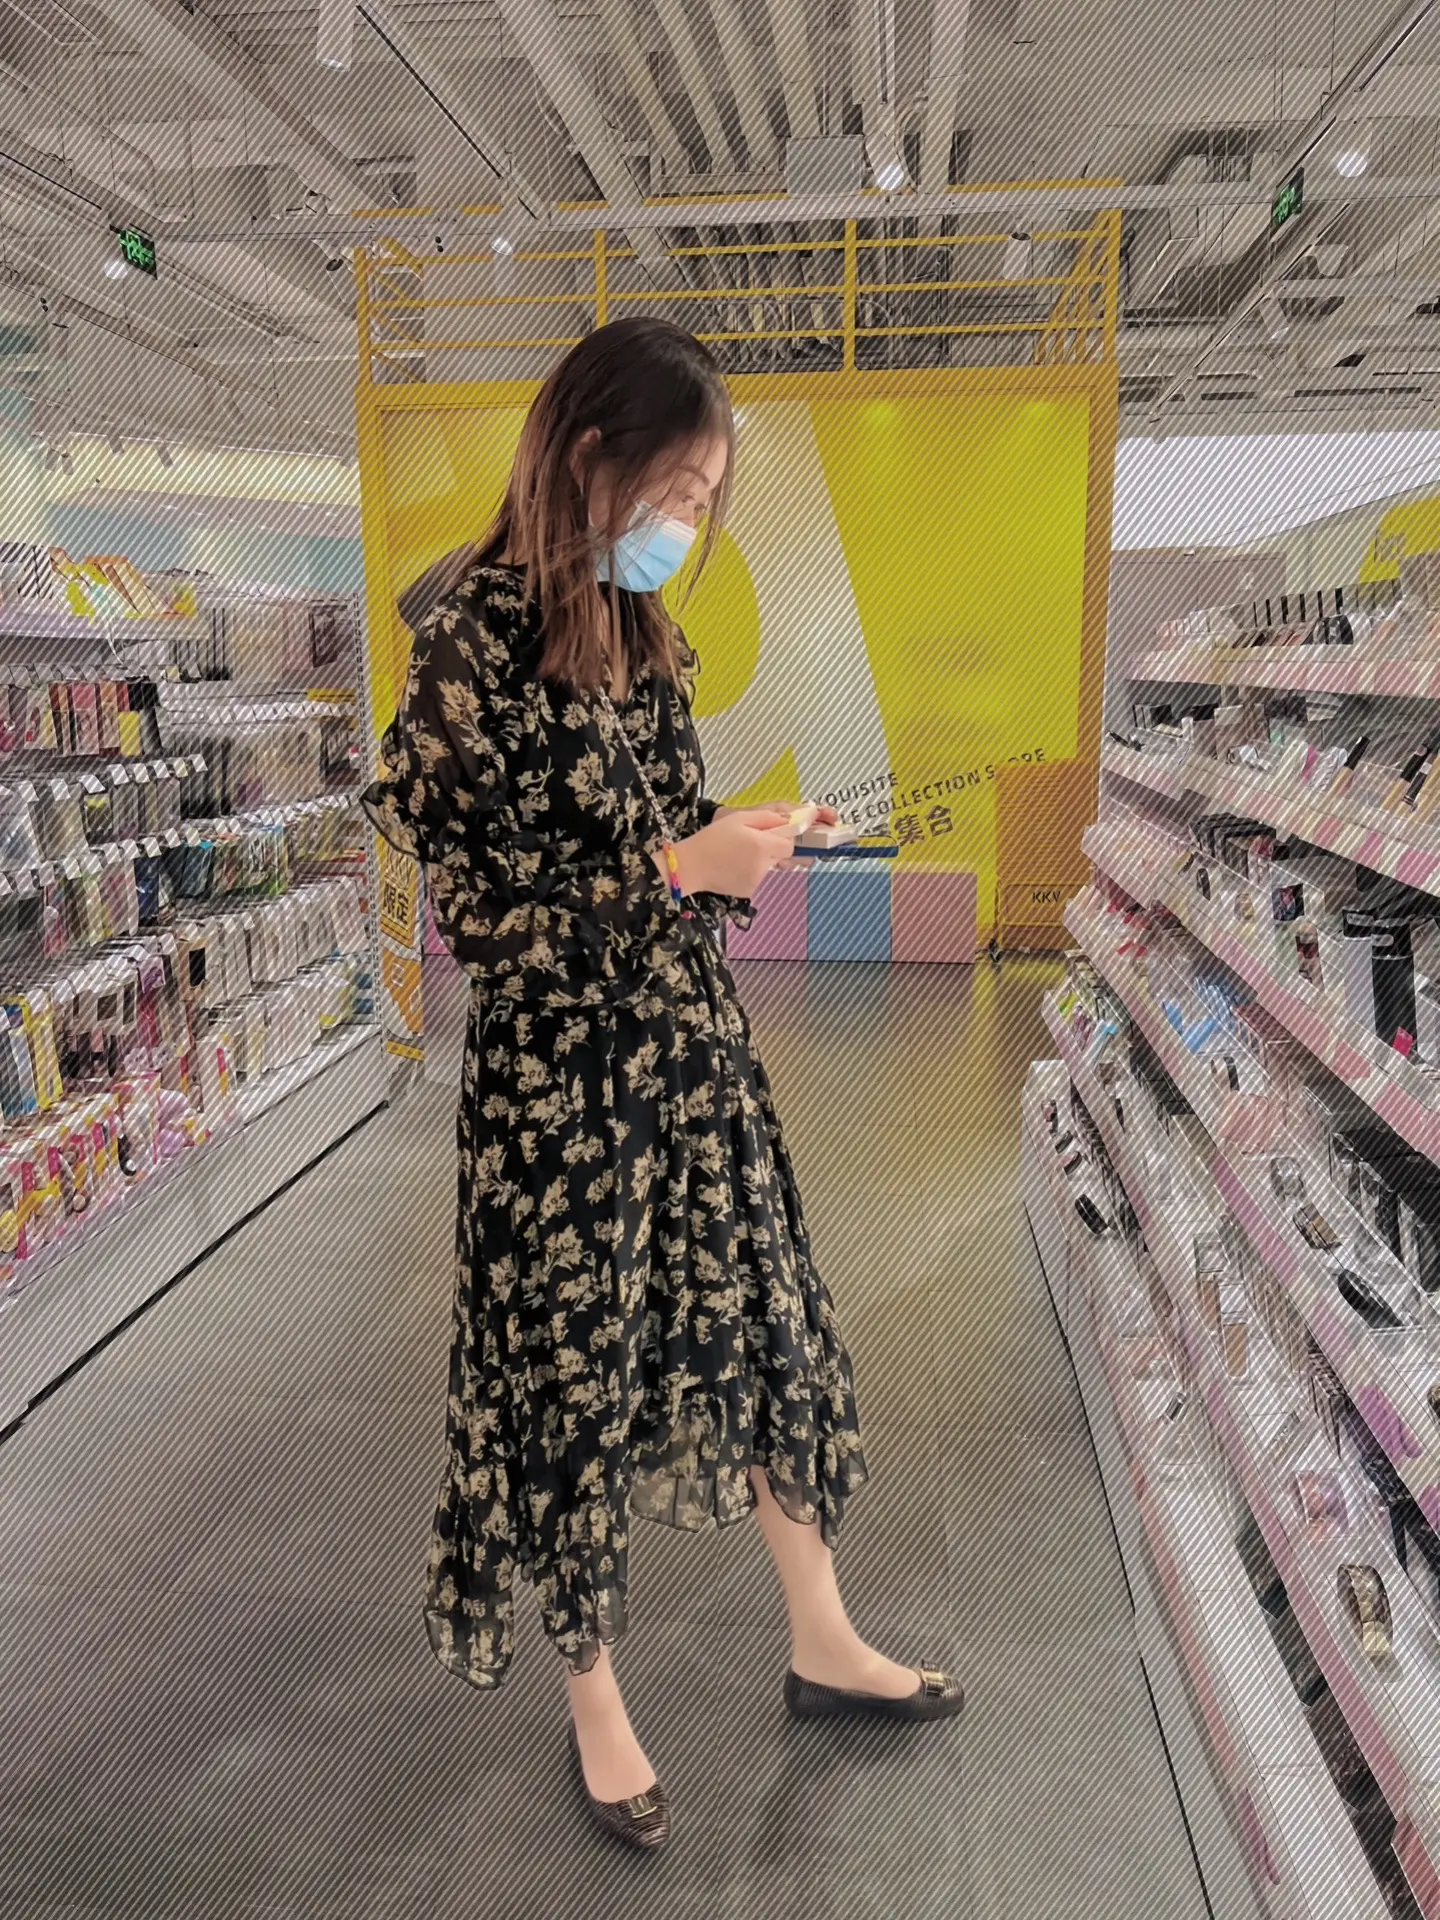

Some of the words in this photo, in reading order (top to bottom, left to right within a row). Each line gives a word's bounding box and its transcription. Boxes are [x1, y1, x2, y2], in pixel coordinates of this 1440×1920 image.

[804, 772, 899, 808] XQUISITE
[867, 769, 981, 818] COLLECTION
[383, 881, 409, 925] 限定
[1032, 890, 1061, 904] KKV
